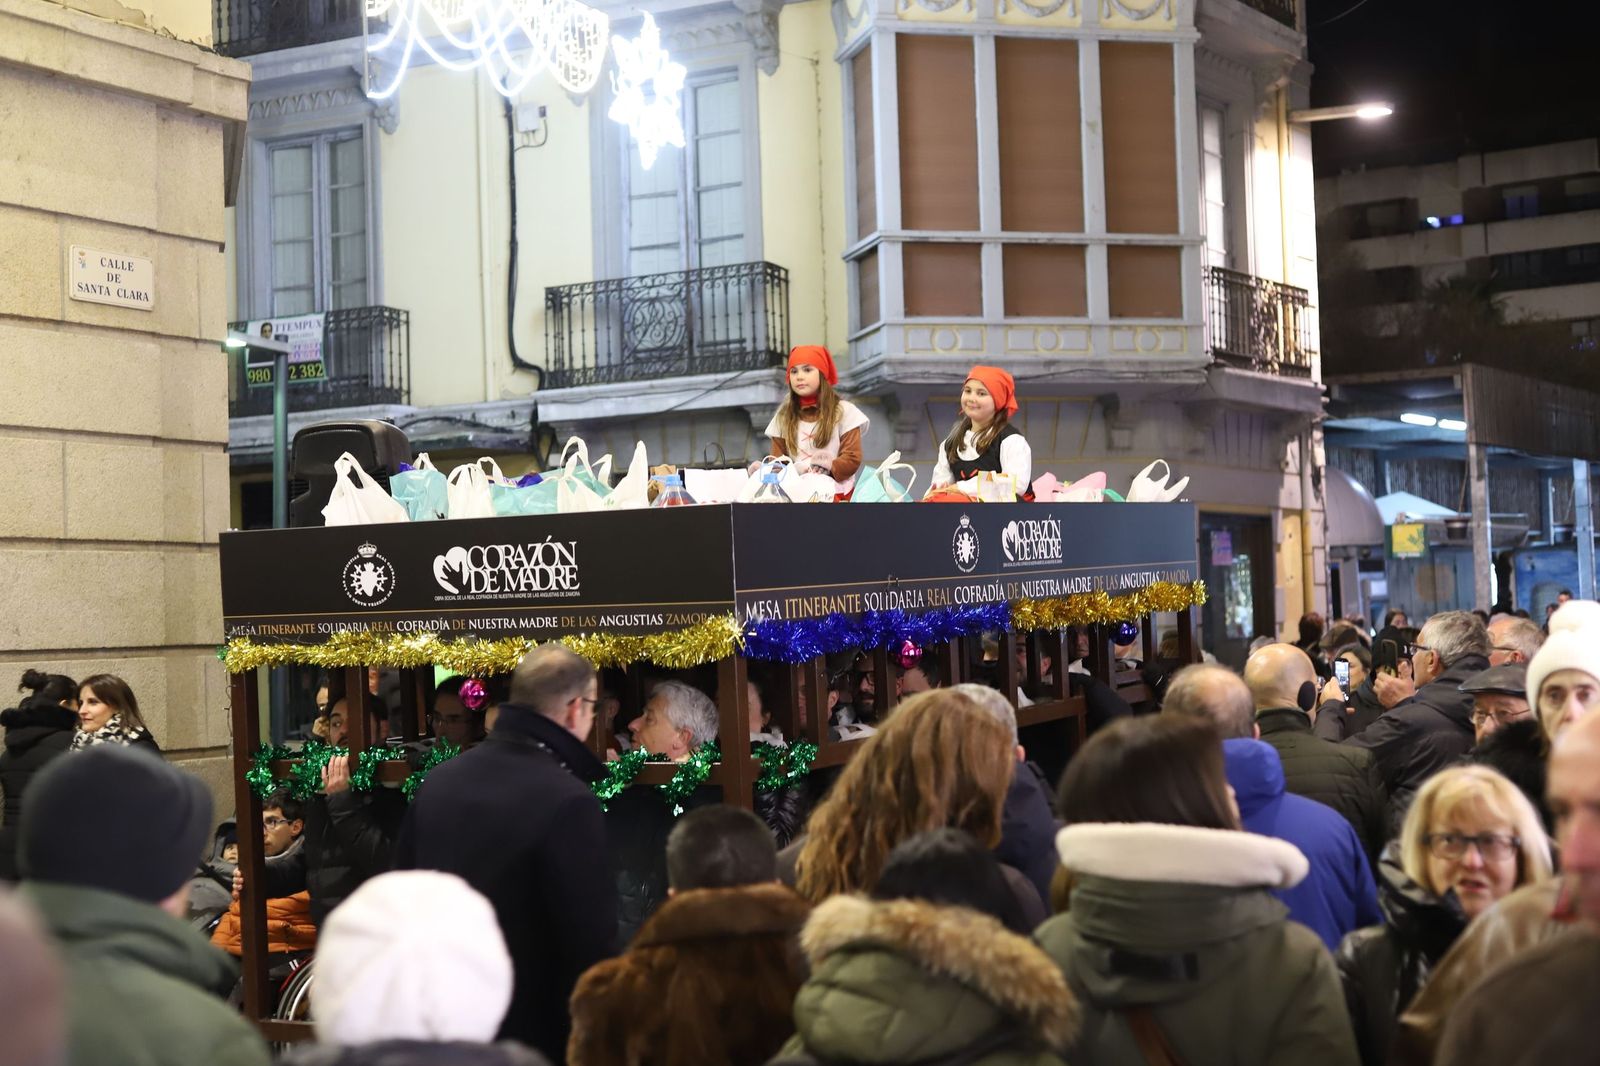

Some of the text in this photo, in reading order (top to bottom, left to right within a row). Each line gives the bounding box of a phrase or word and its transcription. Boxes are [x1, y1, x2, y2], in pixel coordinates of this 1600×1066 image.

[100, 257, 134, 272] CALLE
[107, 272, 121, 284] DE
[77, 282, 149, 302] SANTA CLARA
[248, 368, 271, 383] 980
[299, 363, 324, 378] 382
[1016, 514, 1061, 541] CORAZÓN
[466, 535, 578, 570] CORAZÓN
[1017, 539, 1062, 561] DE MADRE
[468, 565, 580, 594] DE MADRE
[745, 569, 1190, 621] MESA ITINERANTE SOLIDARIA REAL COFRADÍA DE NUESTRA MADRE DE LAS ANGUSTIAS ZAMORA
[231, 613, 712, 636] MESA ITINERANTE SOLIDARIA REAL COFRADÍA DE NUESTRA MADRE DE LAS ANGUSTIAS ZAMOR
